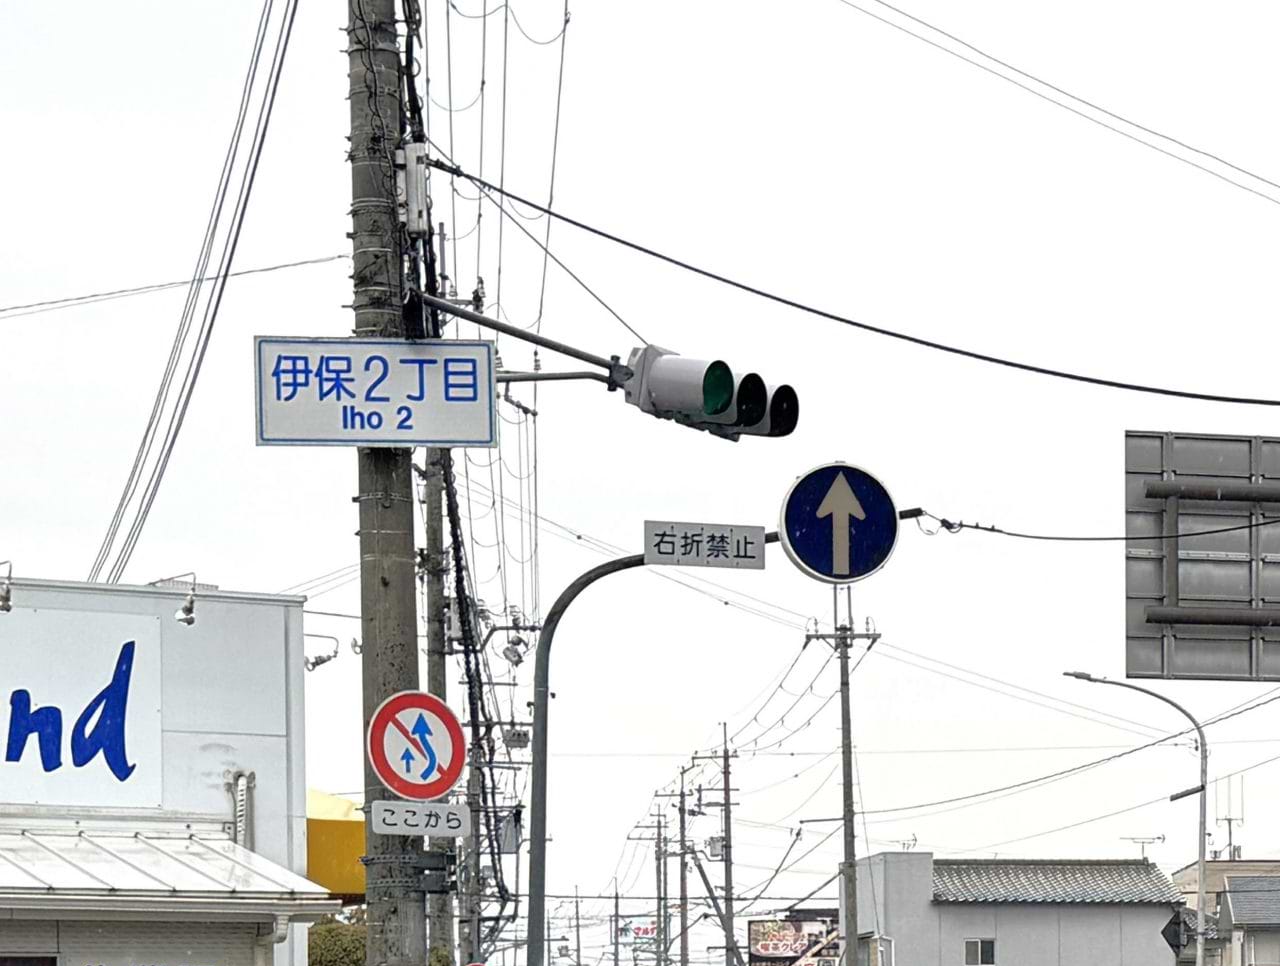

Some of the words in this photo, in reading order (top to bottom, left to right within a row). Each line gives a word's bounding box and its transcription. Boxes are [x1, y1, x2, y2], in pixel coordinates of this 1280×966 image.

[271, 354, 479, 402] 伊保2丁目
[342, 405, 384, 429] Iho
[396, 405, 413, 429] 2
[653, 531, 756, 559] 右折禁止
[382, 809, 462, 829] ここから
